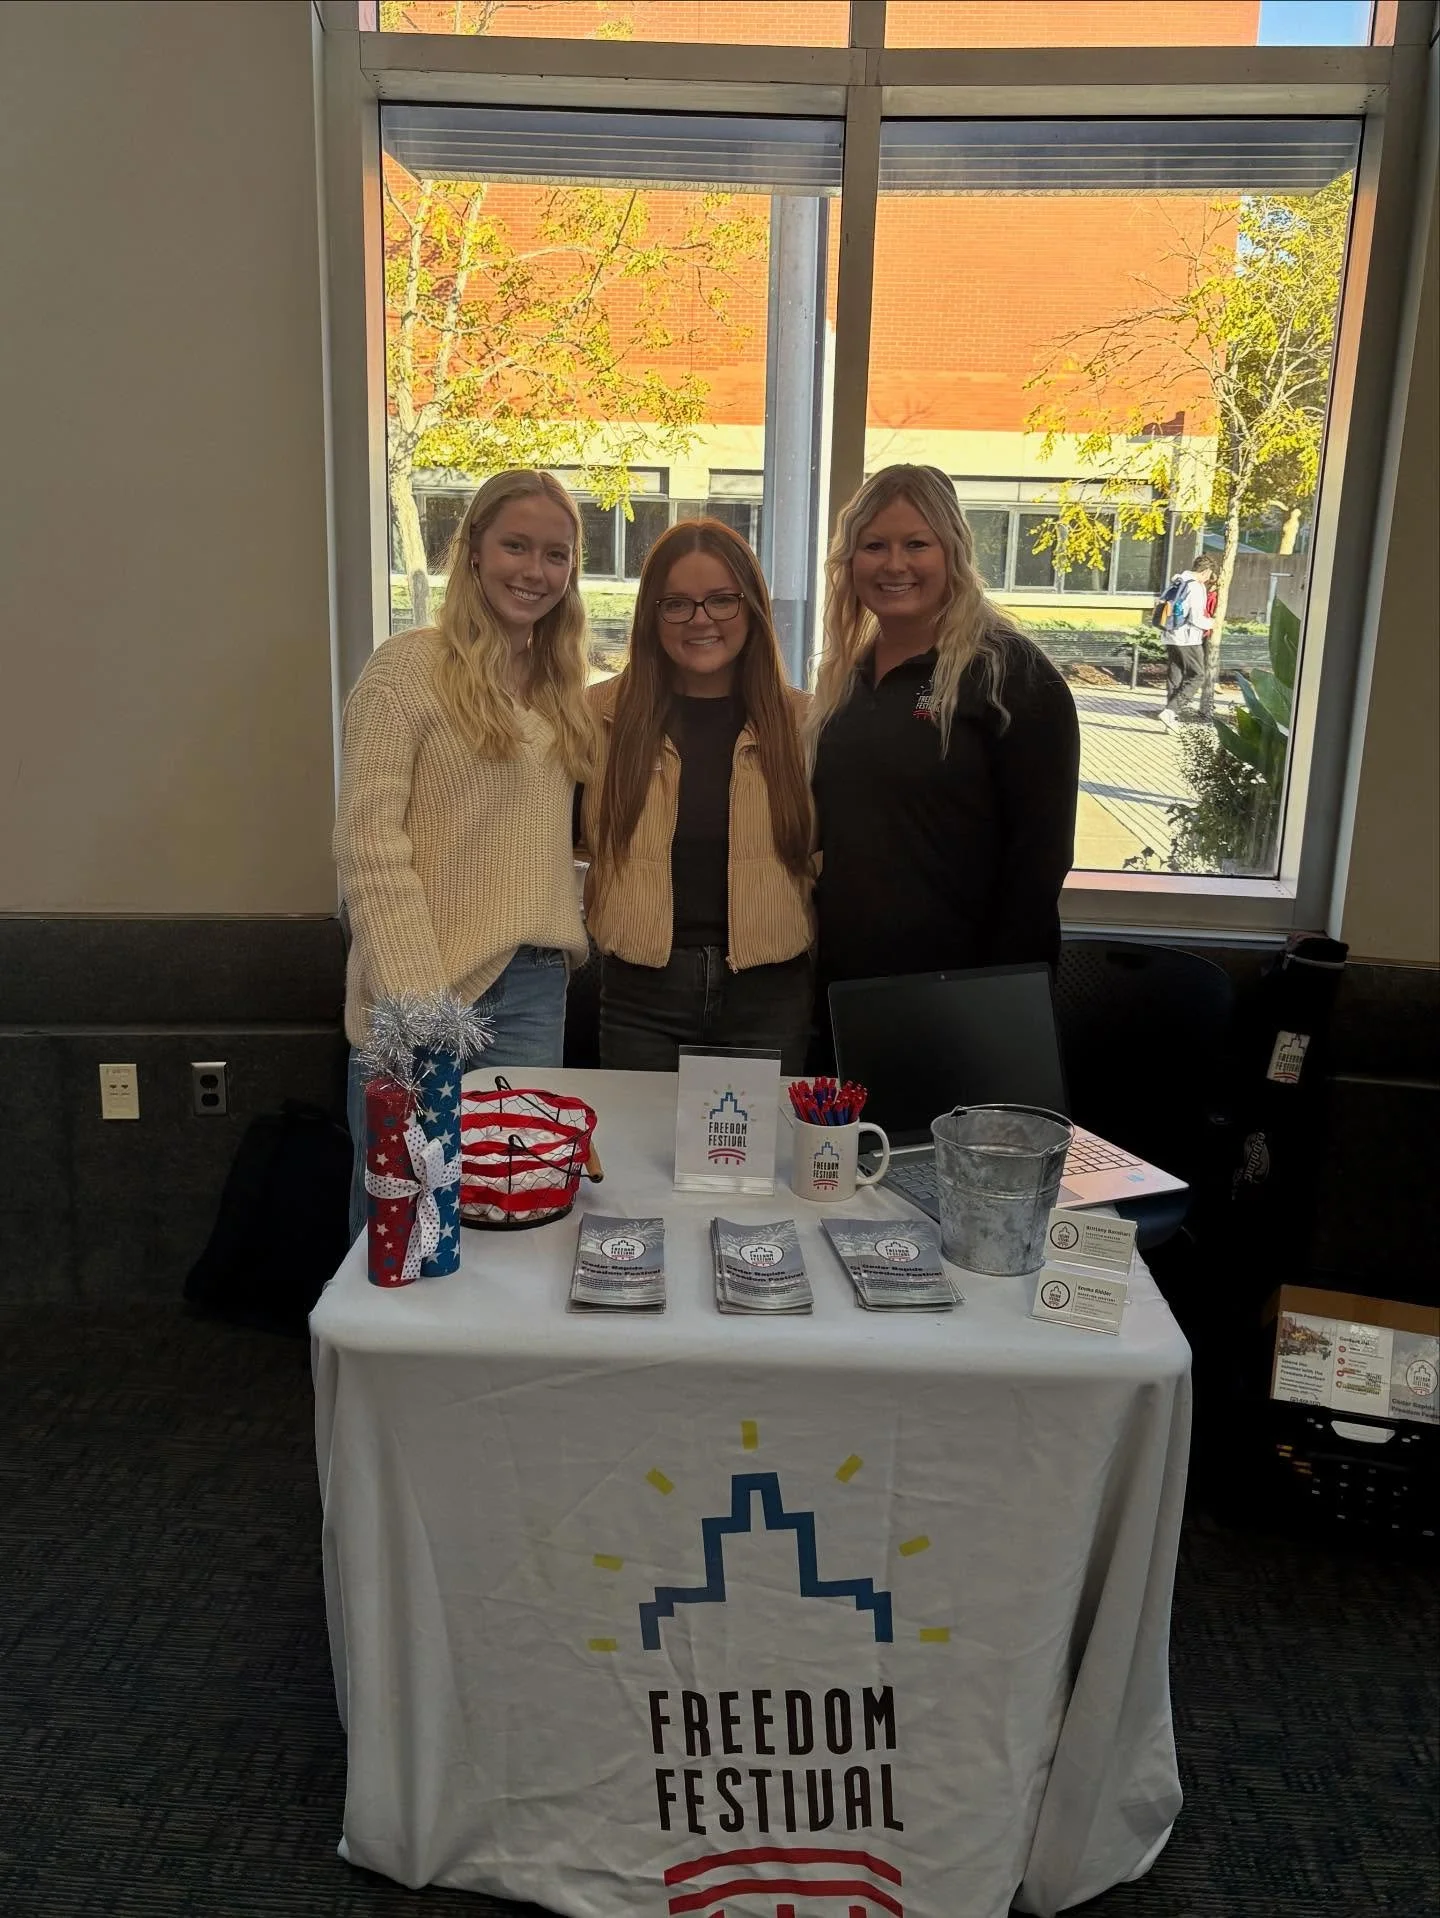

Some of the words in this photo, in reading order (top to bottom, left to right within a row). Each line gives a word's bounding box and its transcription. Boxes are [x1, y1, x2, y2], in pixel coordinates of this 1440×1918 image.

[708, 1121, 747, 1134] FREEDOM
[708, 1134, 747, 1148] FESTIVAL
[813, 1160, 839, 1170] FREEDOM
[813, 1169, 839, 1179] FESTIVAL
[582, 1260, 608, 1269] Cedar
[726, 1264, 752, 1275] Cedar
[581, 1266, 622, 1276] Freedom
[624, 1268, 660, 1276] Festival
[726, 1270, 766, 1282] Freedom
[768, 1271, 804, 1282] Festival
[863, 1269, 904, 1277] Freedom
[649, 1685, 897, 1757] FREEDOM
[655, 1763, 904, 1836] FESTIVAL
